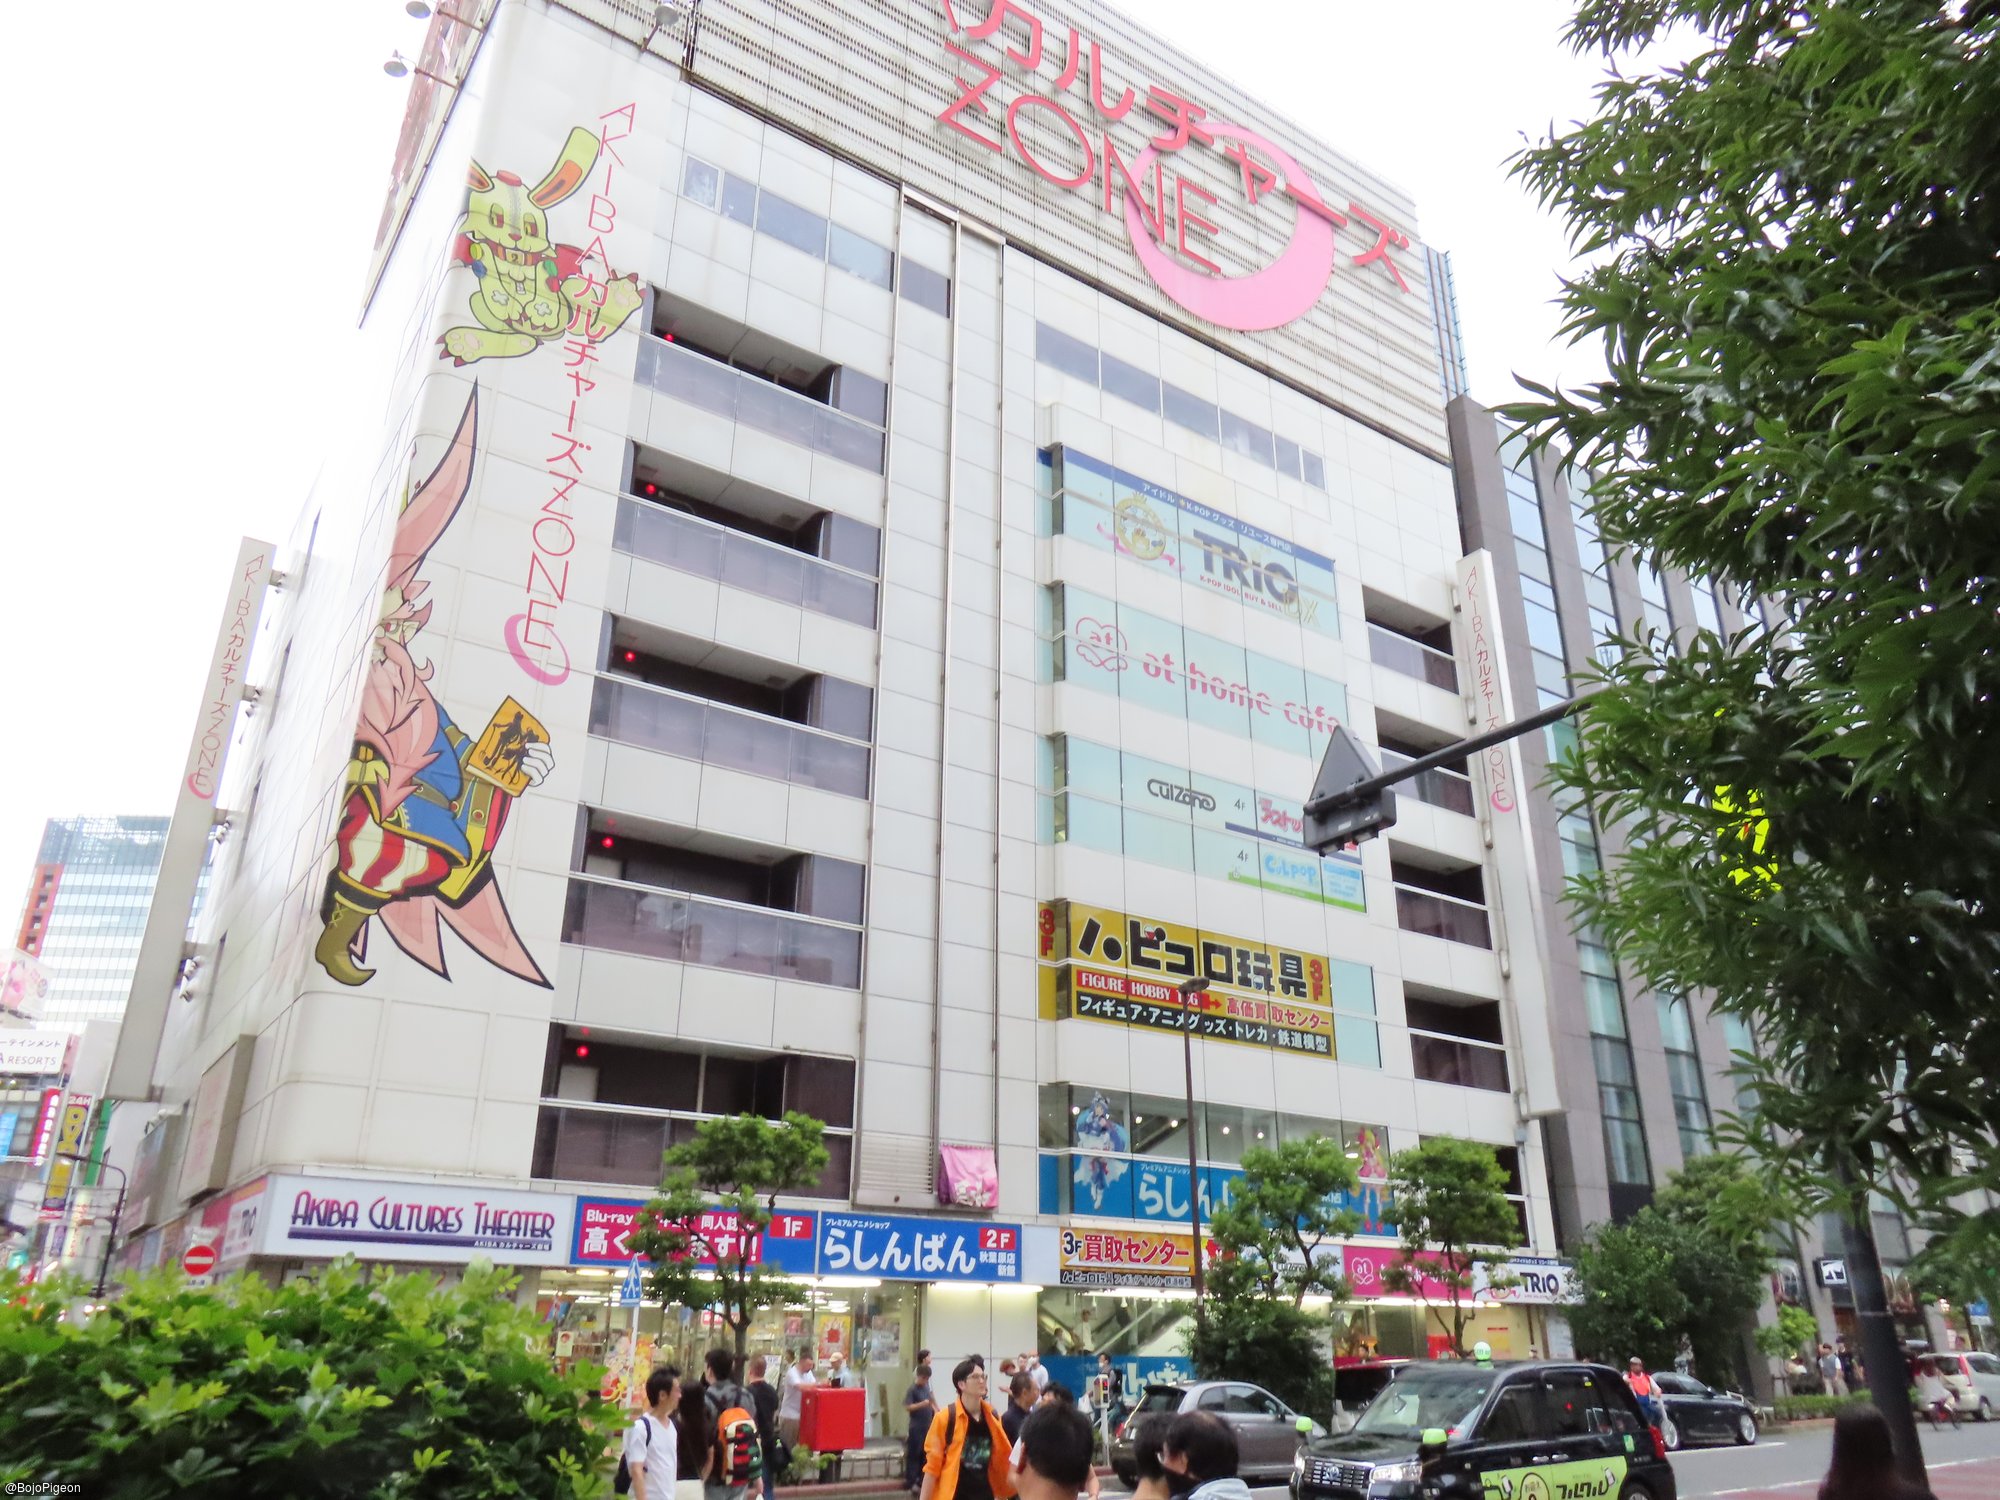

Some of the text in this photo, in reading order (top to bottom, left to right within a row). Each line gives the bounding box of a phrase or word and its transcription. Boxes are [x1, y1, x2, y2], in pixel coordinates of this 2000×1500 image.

[937, 42, 1221, 273] ZONE
[1243, 592, 1260, 604] BUY
[1189, 662, 1271, 715] home
[1234, 798, 1246, 811] 4F
[1237, 850, 1248, 863] 4F
[1039, 908, 1055, 957] 3F
[1081, 972, 1126, 993] FIGURE
[1131, 981, 1171, 1001] HOBBY
[1309, 958, 1325, 1001] 3F
[1227, 997, 1330, 1029] 高価買取センター
[8, 1055, 57, 1066] RESORTS
[291, 1190, 359, 1228] AKIBA
[586, 1209, 634, 1225] Blu-ray
[783, 1216, 803, 1238] 1F
[826, 1217, 890, 1230] プレミアムアニメショップ
[824, 1228, 976, 1275] らしんばん
[986, 1229, 1010, 1248] 2F
[1063, 1232, 1190, 1264] 3F 買取センター
[1520, 1272, 1559, 1296] TRIO
